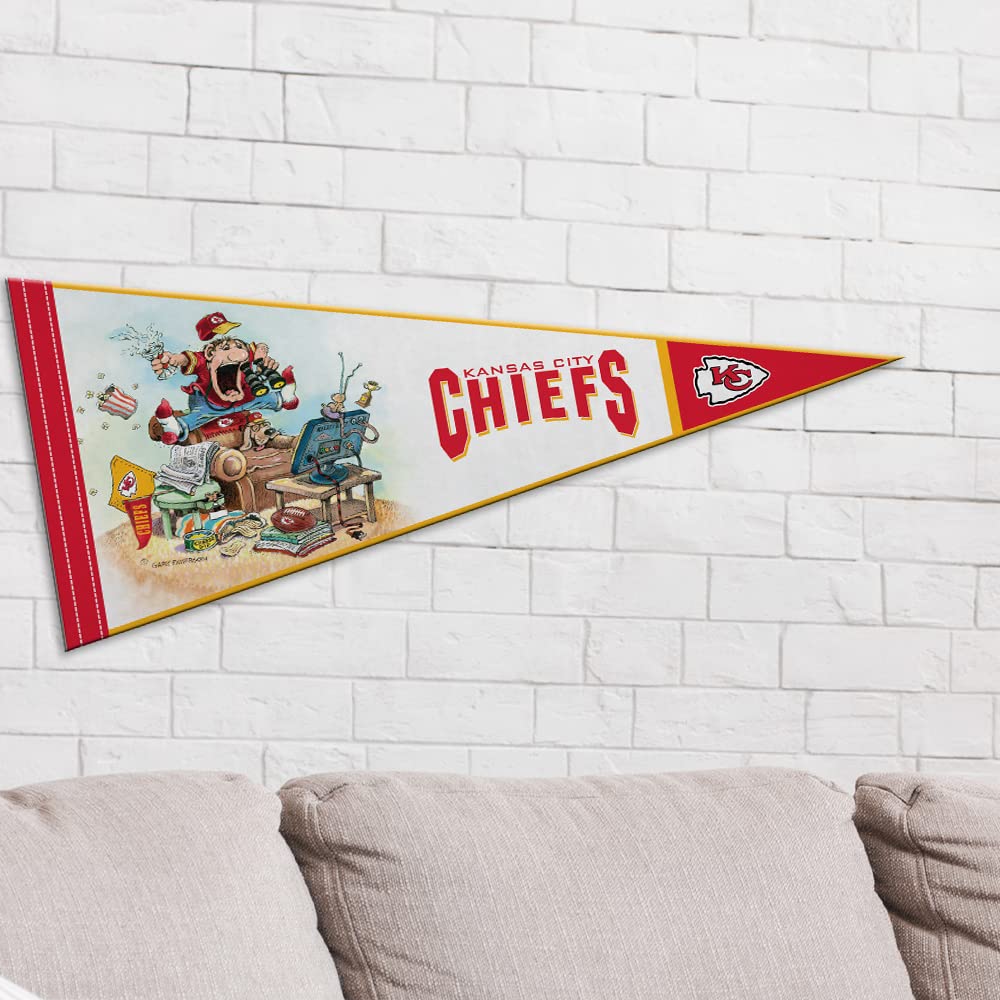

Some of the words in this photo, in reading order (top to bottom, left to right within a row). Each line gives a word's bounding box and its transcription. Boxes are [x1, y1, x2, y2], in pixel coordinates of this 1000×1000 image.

[463, 361, 545, 379] KANSAS
[553, 355, 594, 368] CITY
[710, 363, 753, 391] KC
[428, 349, 640, 463] CHIEFS
[132, 503, 151, 536] CHIEFS
